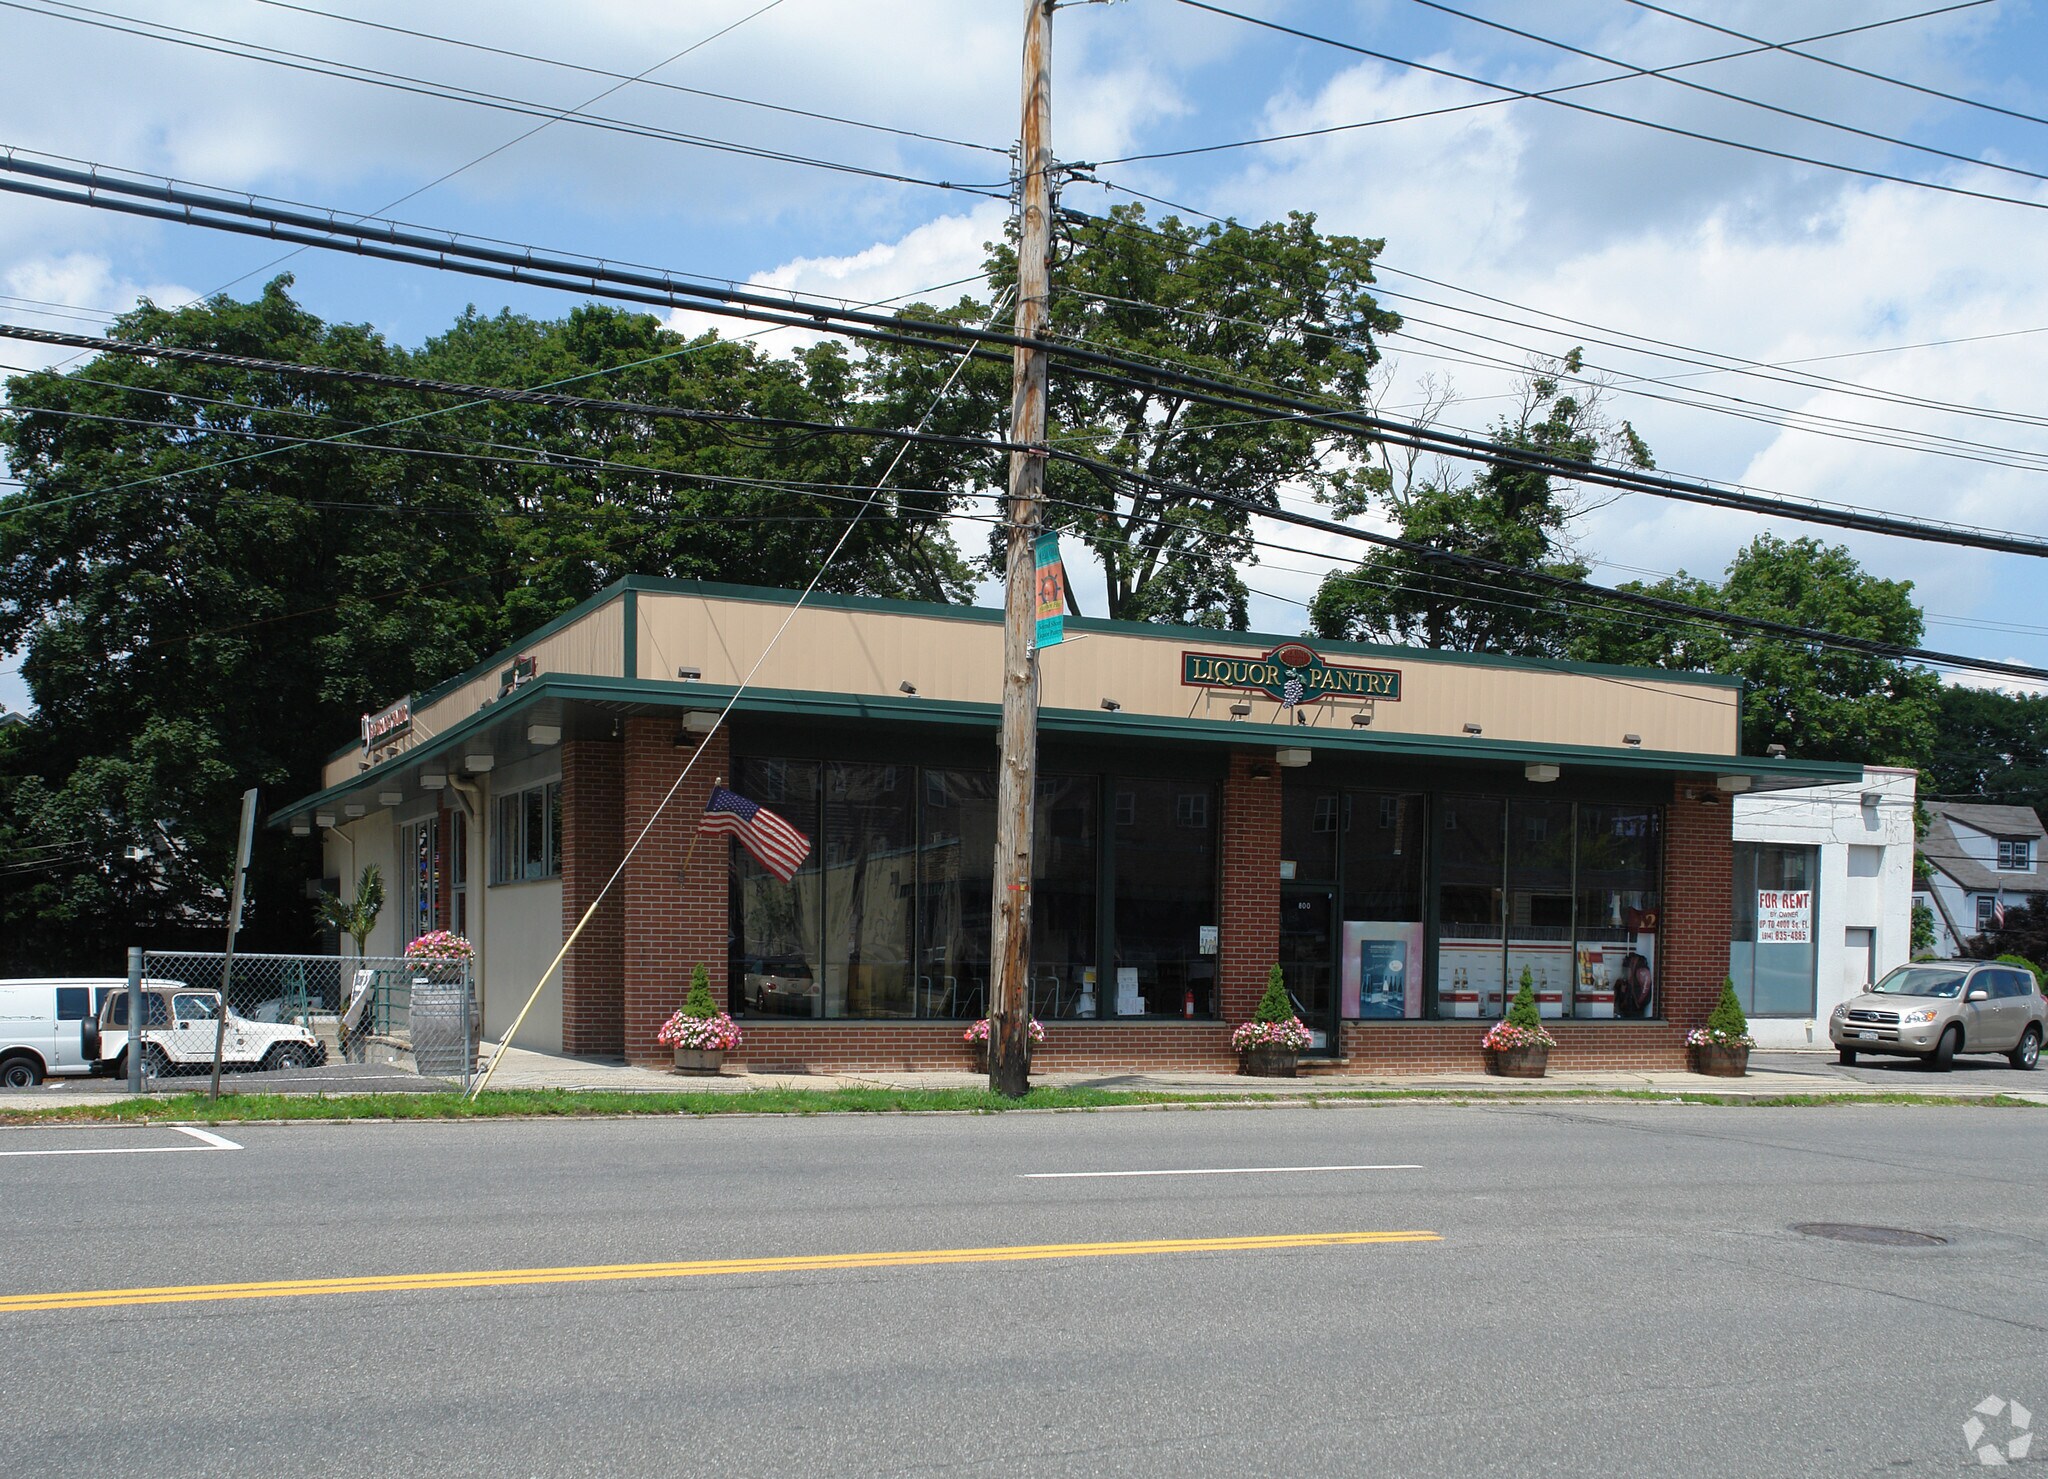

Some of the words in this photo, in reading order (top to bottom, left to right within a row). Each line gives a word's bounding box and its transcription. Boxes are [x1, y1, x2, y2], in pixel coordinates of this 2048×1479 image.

[1193, 658, 1281, 686] LIQUOR
[1309, 668, 1395, 694] PANTRY
[1760, 892, 1778, 908] FOR
[1782, 893, 1809, 908] RENT
[1768, 920, 1775, 928] TO
